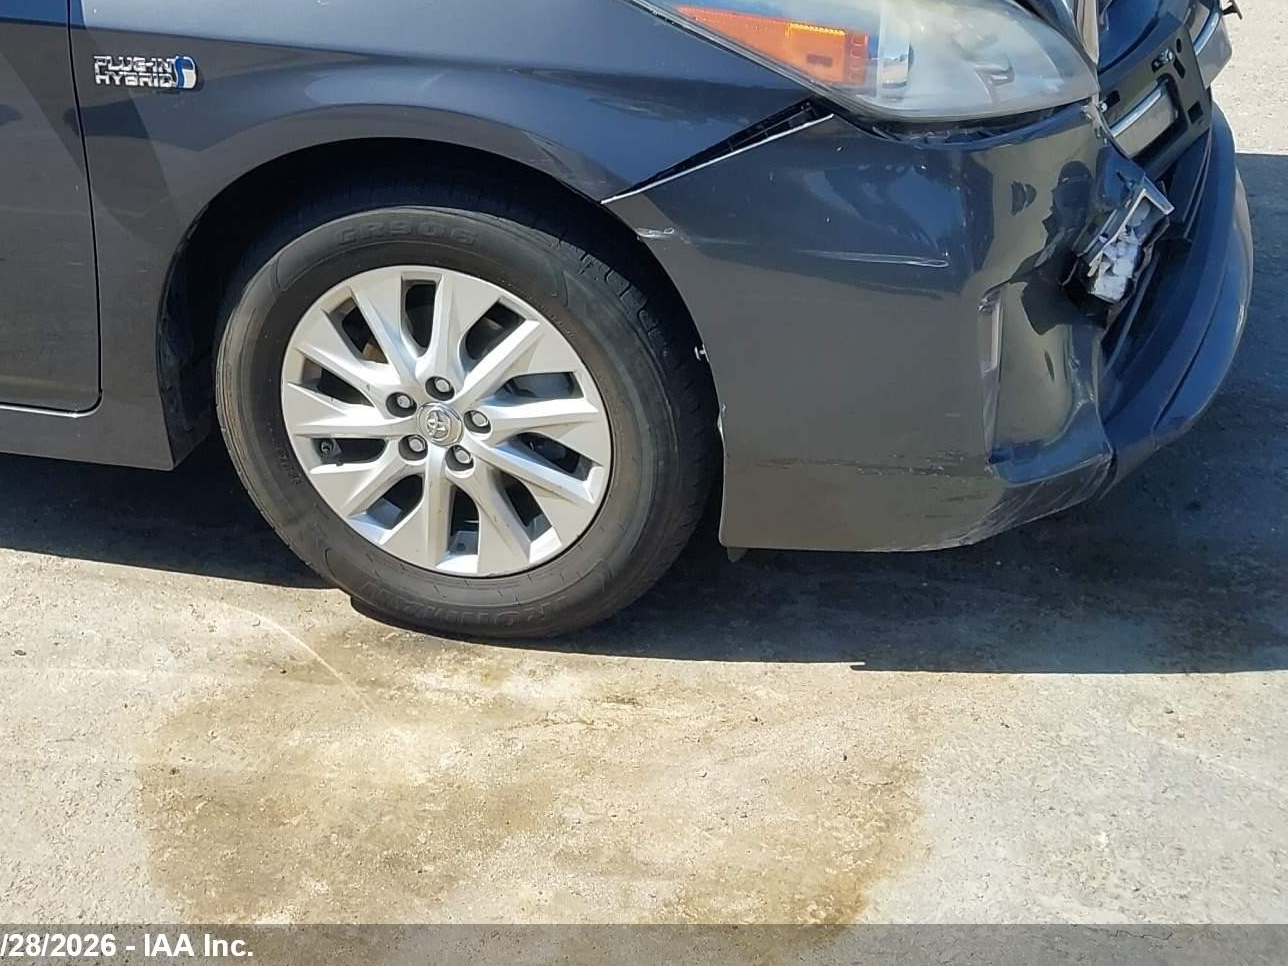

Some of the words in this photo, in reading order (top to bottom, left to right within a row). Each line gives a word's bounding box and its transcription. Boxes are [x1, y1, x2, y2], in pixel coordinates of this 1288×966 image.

[93, 55, 175, 73] PLUG-IN
[94, 71, 177, 88] HYBRID
[336, 219, 476, 246] GR906
